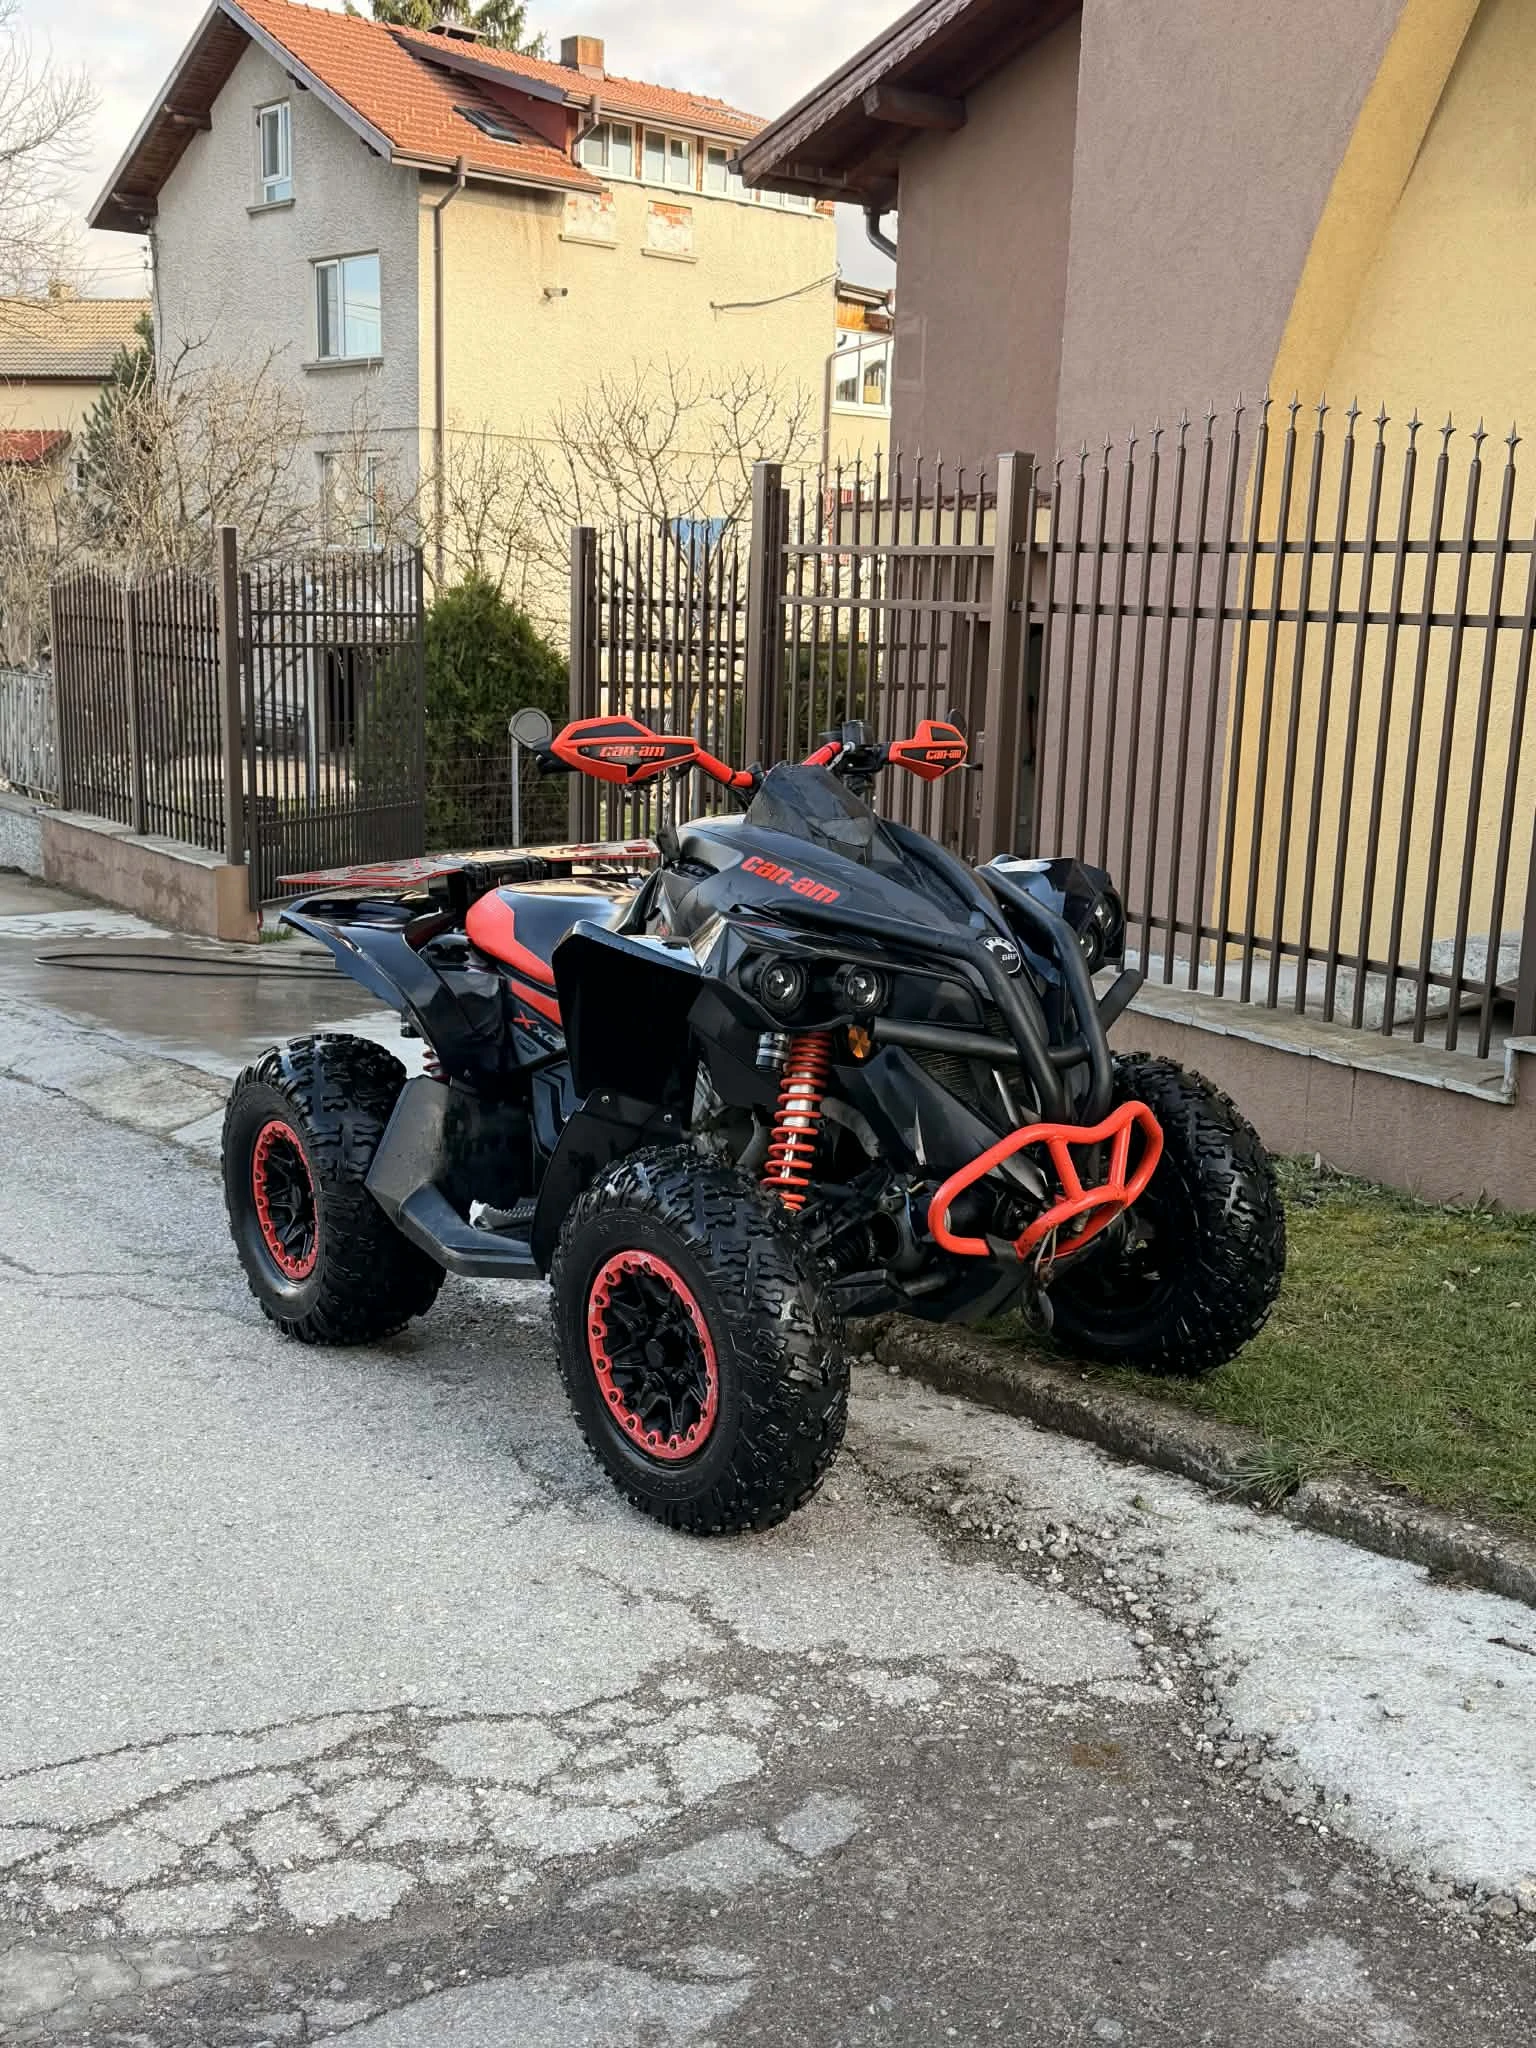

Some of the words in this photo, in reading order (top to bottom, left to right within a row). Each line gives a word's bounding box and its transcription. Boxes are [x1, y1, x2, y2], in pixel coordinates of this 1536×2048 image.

[600, 745, 665, 758] can-am
[926, 749, 962, 761] can-am
[741, 856, 841, 904] can-am
